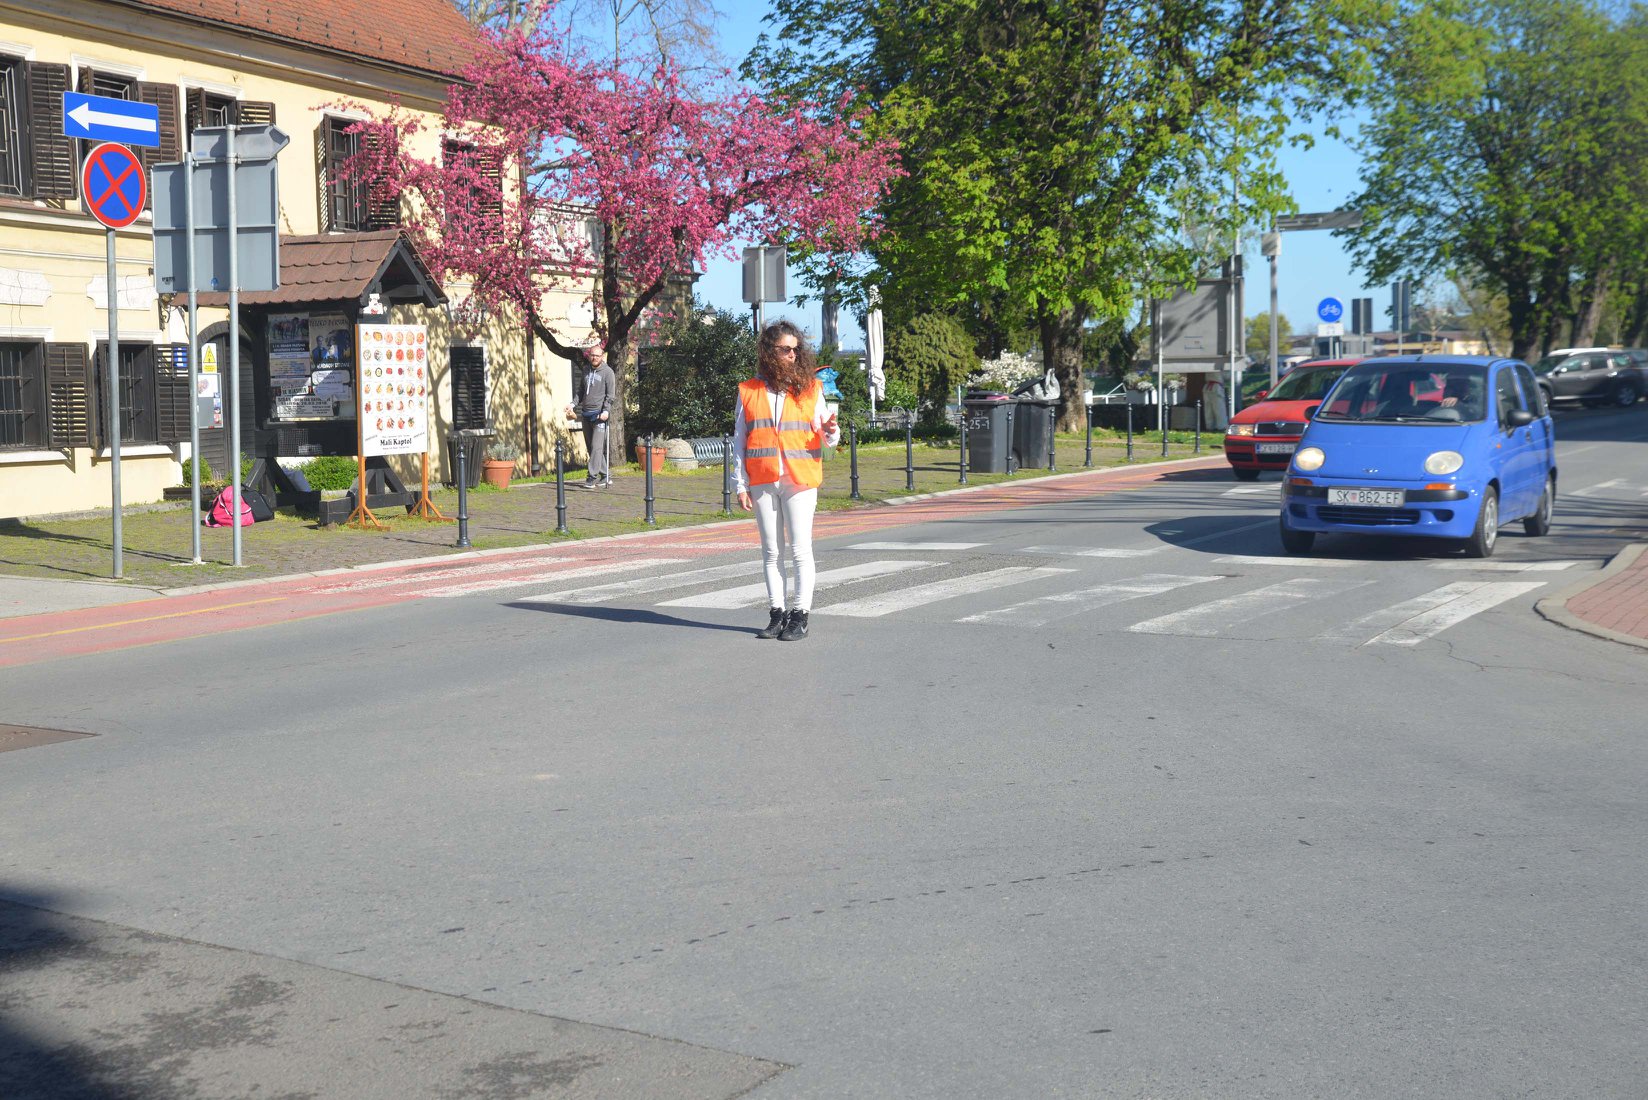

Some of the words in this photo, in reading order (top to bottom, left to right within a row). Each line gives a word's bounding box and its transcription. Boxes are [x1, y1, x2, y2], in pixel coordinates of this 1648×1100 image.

[969, 419, 990, 430] 25-1
[393, 437, 412, 446] Kaptol
[1336, 490, 1350, 502] SK
